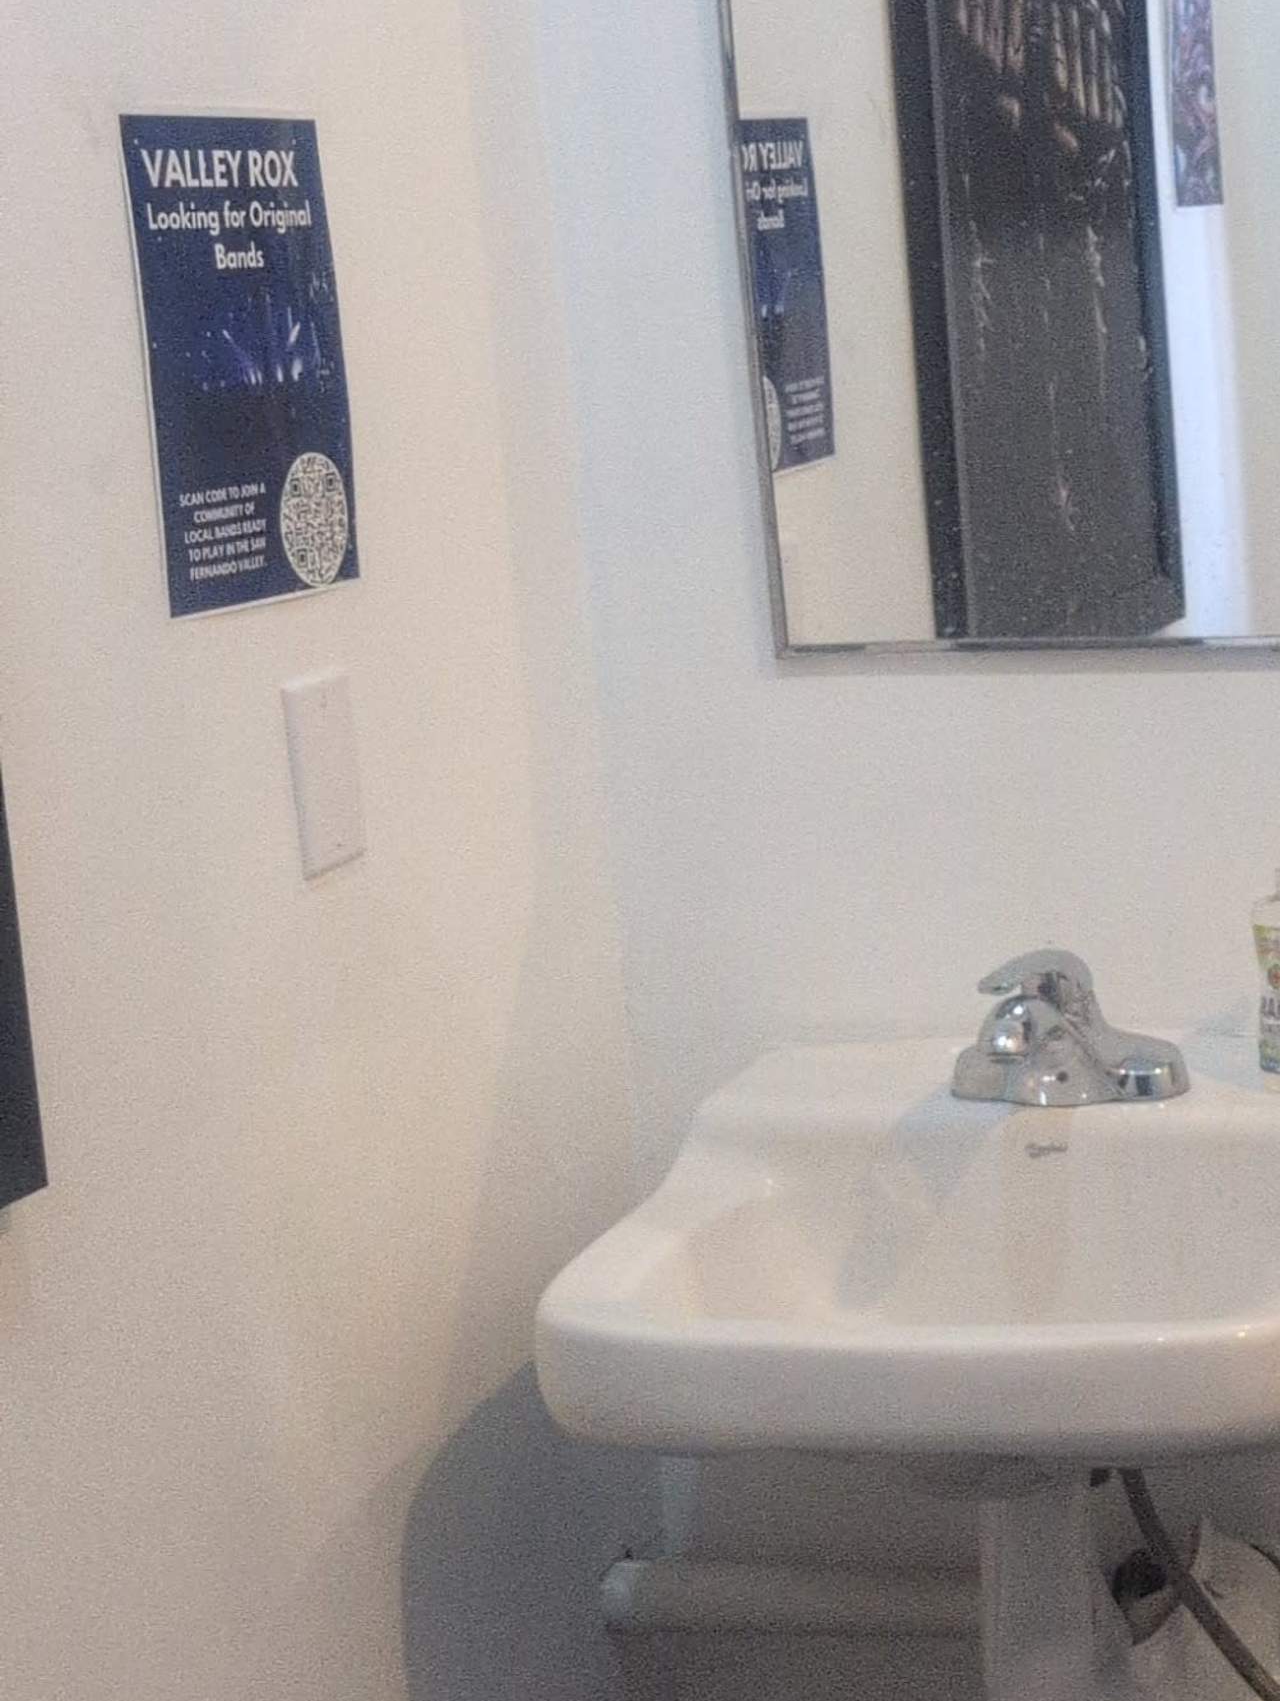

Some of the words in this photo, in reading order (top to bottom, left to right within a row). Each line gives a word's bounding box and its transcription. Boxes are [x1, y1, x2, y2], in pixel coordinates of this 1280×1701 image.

[140, 148, 242, 189] VALLEY
[247, 149, 300, 189] ROX
[147, 200, 221, 236] Looking
[223, 200, 247, 229] for
[249, 199, 313, 235] Original
[213, 241, 265, 270] Bands
[179, 491, 205, 508] SCAN
[205, 487, 228, 504] CODE
[228, 485, 241, 500] TO
[241, 483, 259, 499] JOIN
[184, 528, 215, 544] LOCAL
[188, 548, 202, 563] TO
[202, 544, 225, 561] PLAY
[225, 542, 236, 557] IN
